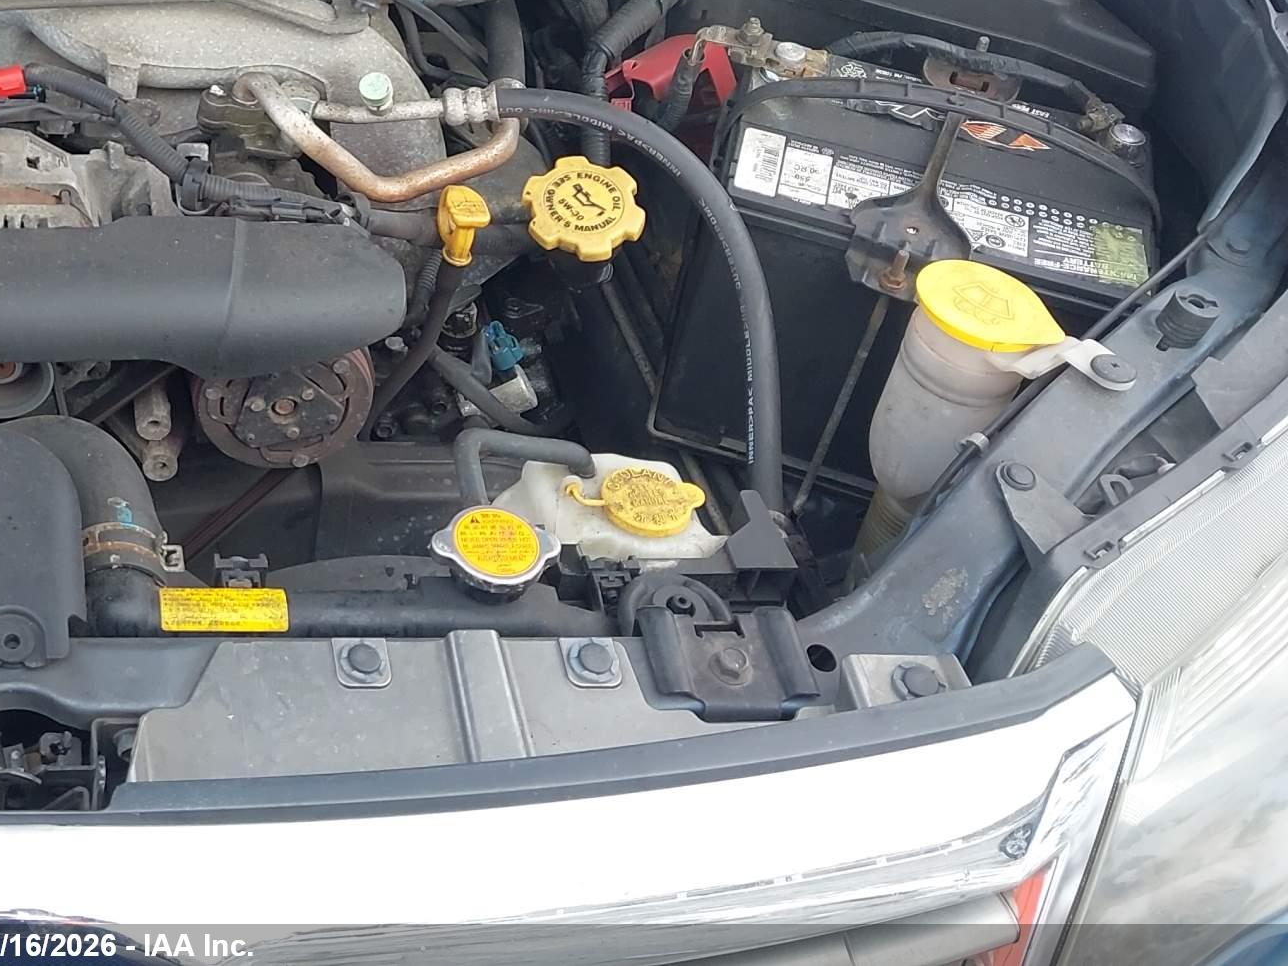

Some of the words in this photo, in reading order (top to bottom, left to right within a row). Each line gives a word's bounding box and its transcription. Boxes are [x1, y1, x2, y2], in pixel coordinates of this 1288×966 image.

[545, 189, 571, 229] OWNER'S
[573, 216, 617, 232] MANUAL
[551, 174, 572, 189] SEE
[576, 172, 617, 194] ENGINE
[611, 195, 621, 212] OIL
[606, 468, 674, 491] COOLANT
